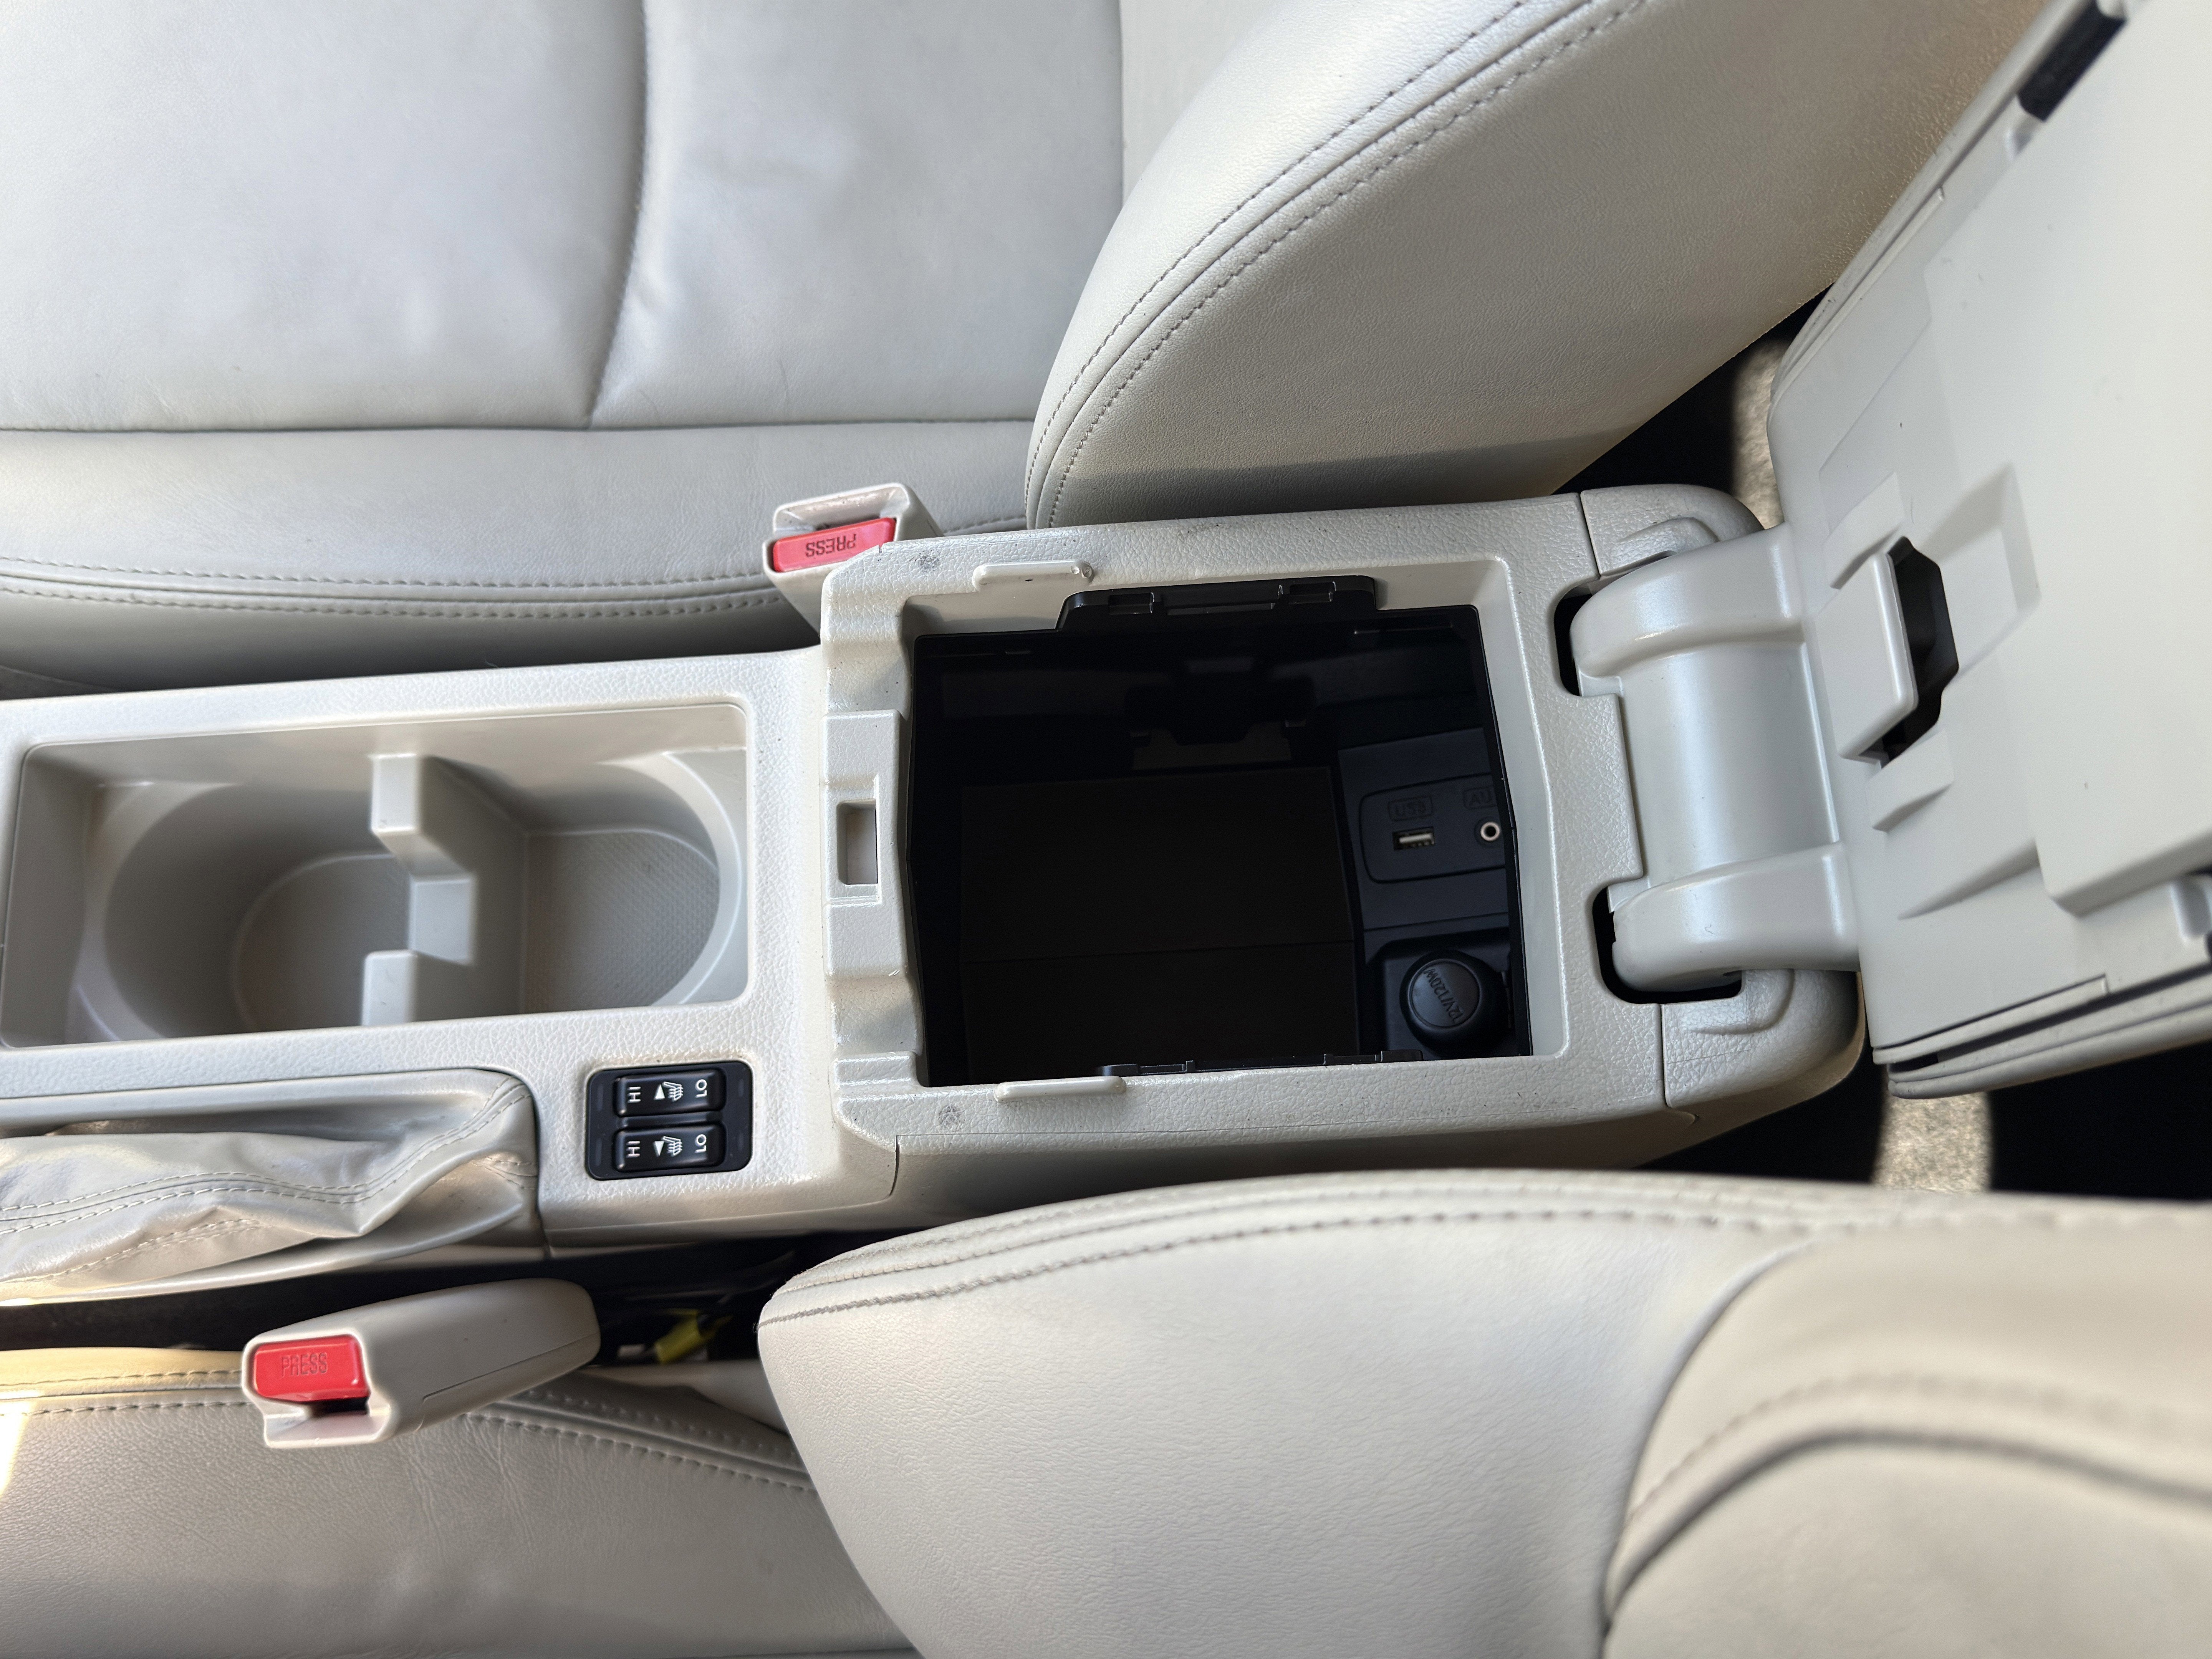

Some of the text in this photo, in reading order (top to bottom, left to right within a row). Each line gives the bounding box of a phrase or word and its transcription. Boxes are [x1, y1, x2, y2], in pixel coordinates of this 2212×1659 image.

[806, 533, 856, 557] PRESS
[1469, 789, 1493, 805] AU
[1395, 800, 1427, 817] USB
[1423, 968, 1464, 1023] 12V/120W
[628, 1086, 641, 1103] HI
[695, 1079, 707, 1098] LO
[626, 1141, 640, 1157] HI
[695, 1134, 707, 1153] LO
[281, 1352, 328, 1377] PRESS
